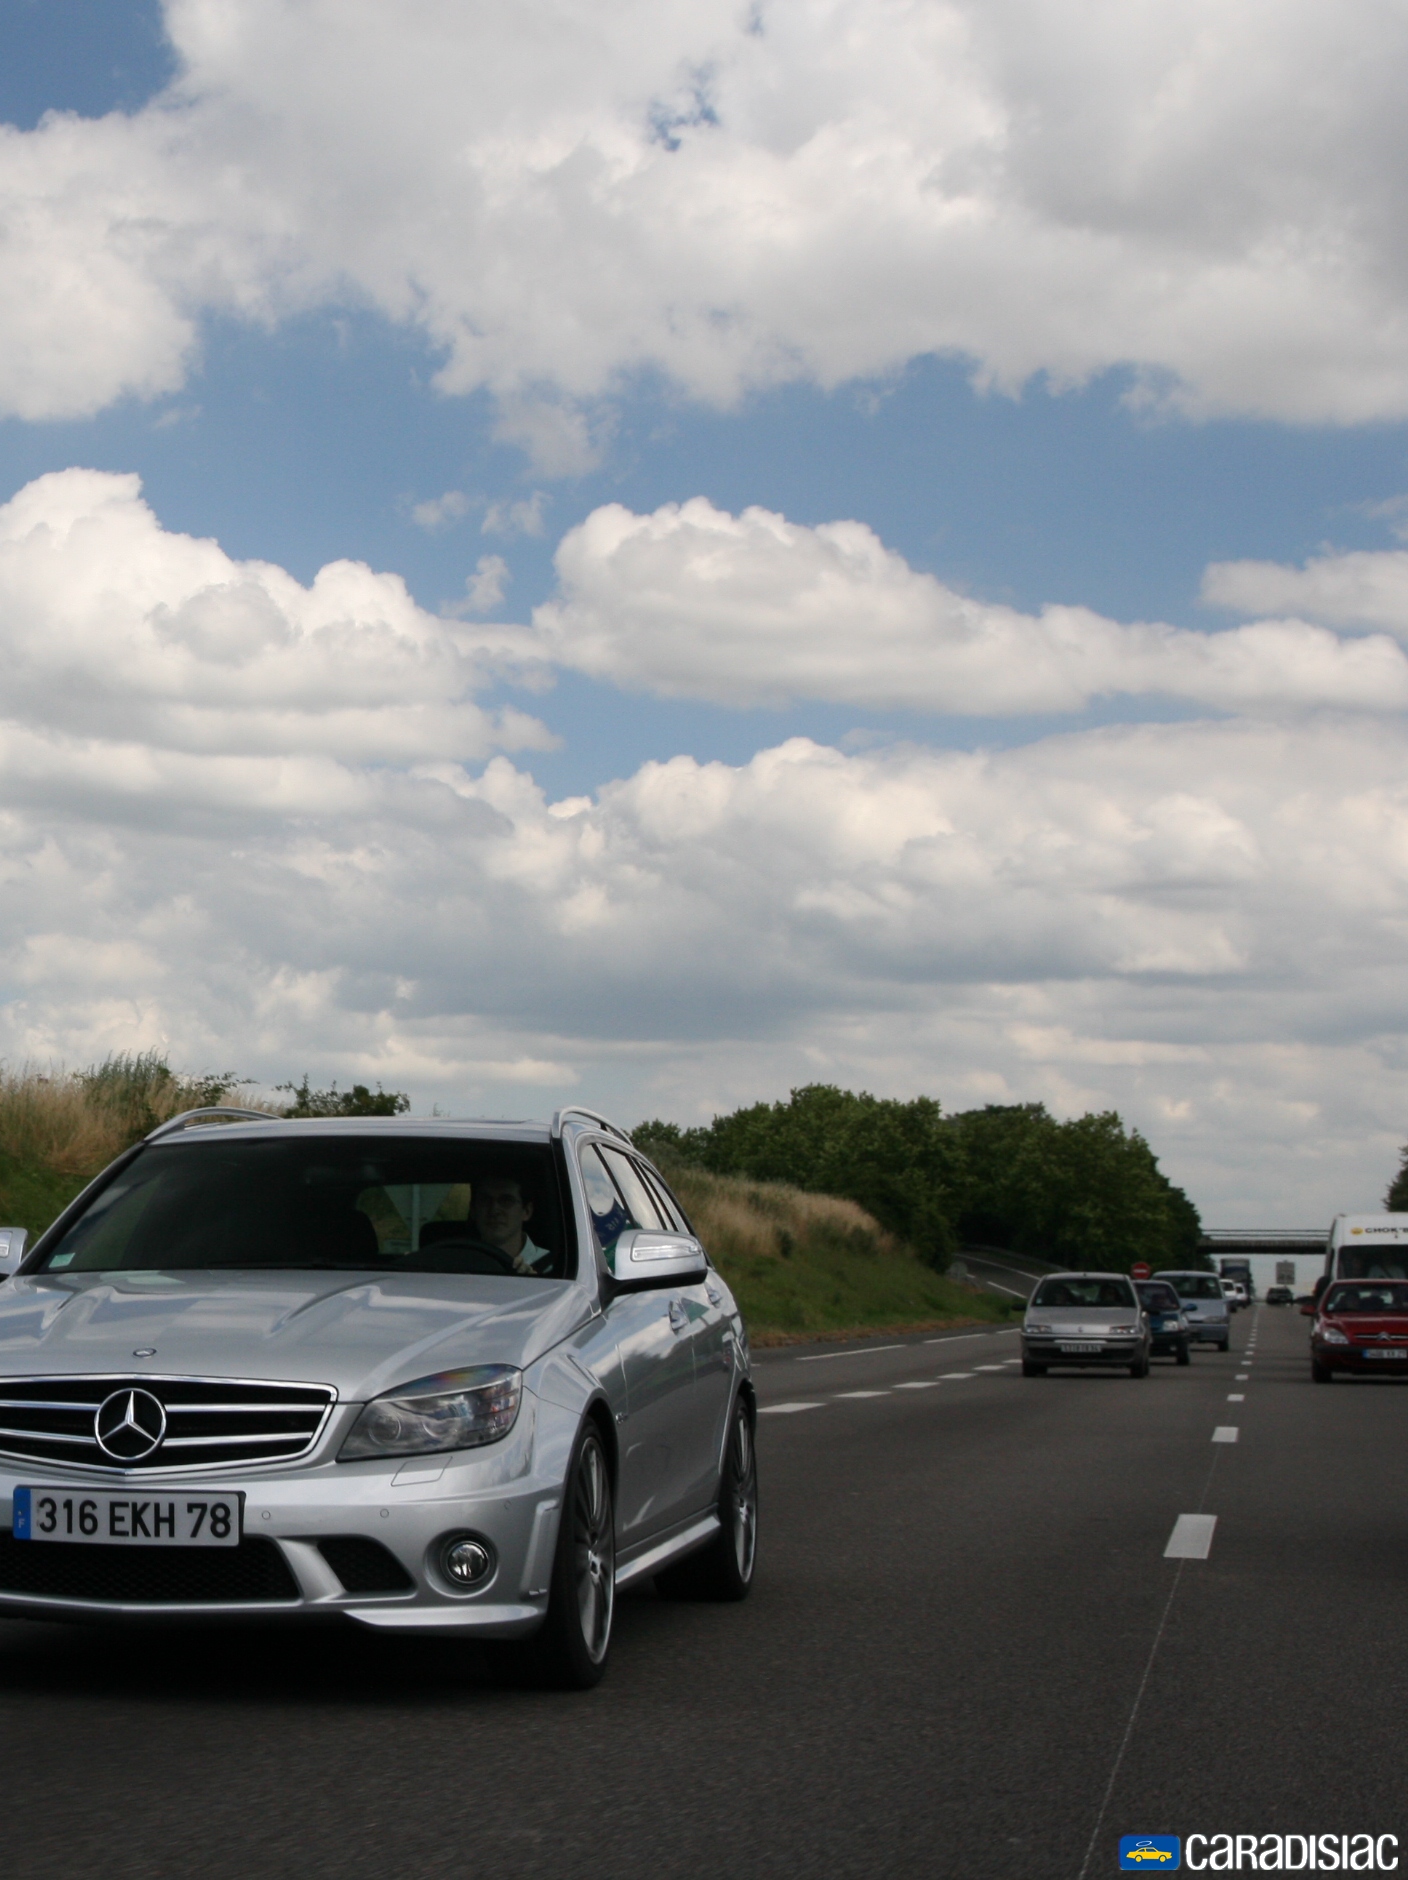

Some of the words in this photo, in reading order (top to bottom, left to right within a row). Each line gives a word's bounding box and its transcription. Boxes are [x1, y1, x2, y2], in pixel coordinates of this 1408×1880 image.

[39, 1497, 98, 1535] 316
[109, 1501, 175, 1538] EKH
[187, 1502, 231, 1538] 78
